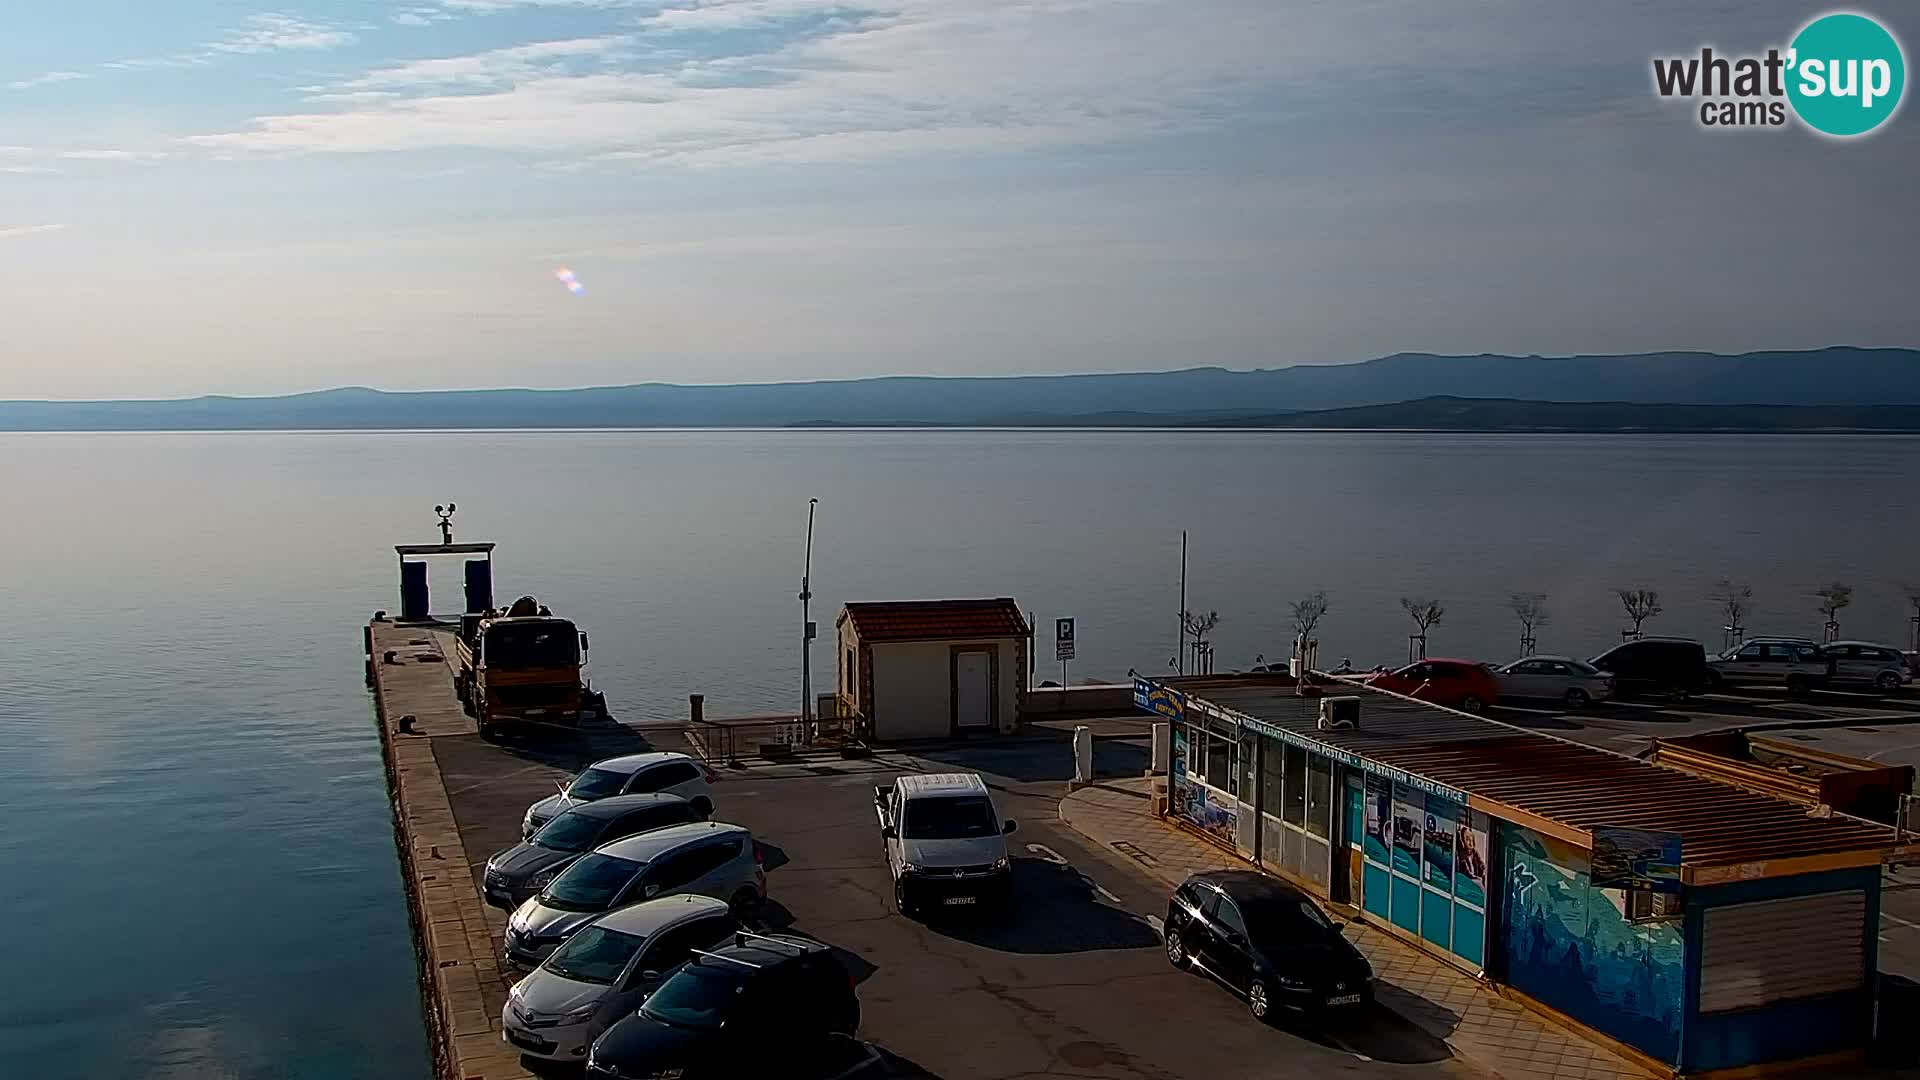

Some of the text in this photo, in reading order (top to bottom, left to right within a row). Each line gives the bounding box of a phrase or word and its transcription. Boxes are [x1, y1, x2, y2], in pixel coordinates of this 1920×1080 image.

[1284, 734, 1321, 753] AUTOBUSNA
[1321, 746, 1351, 764] POSTAJA
[1360, 760, 1376, 772] BUS
[1376, 765, 1407, 783] STATION
[1409, 775, 1435, 793] TICKET
[1436, 785, 1463, 802] OFFICE
